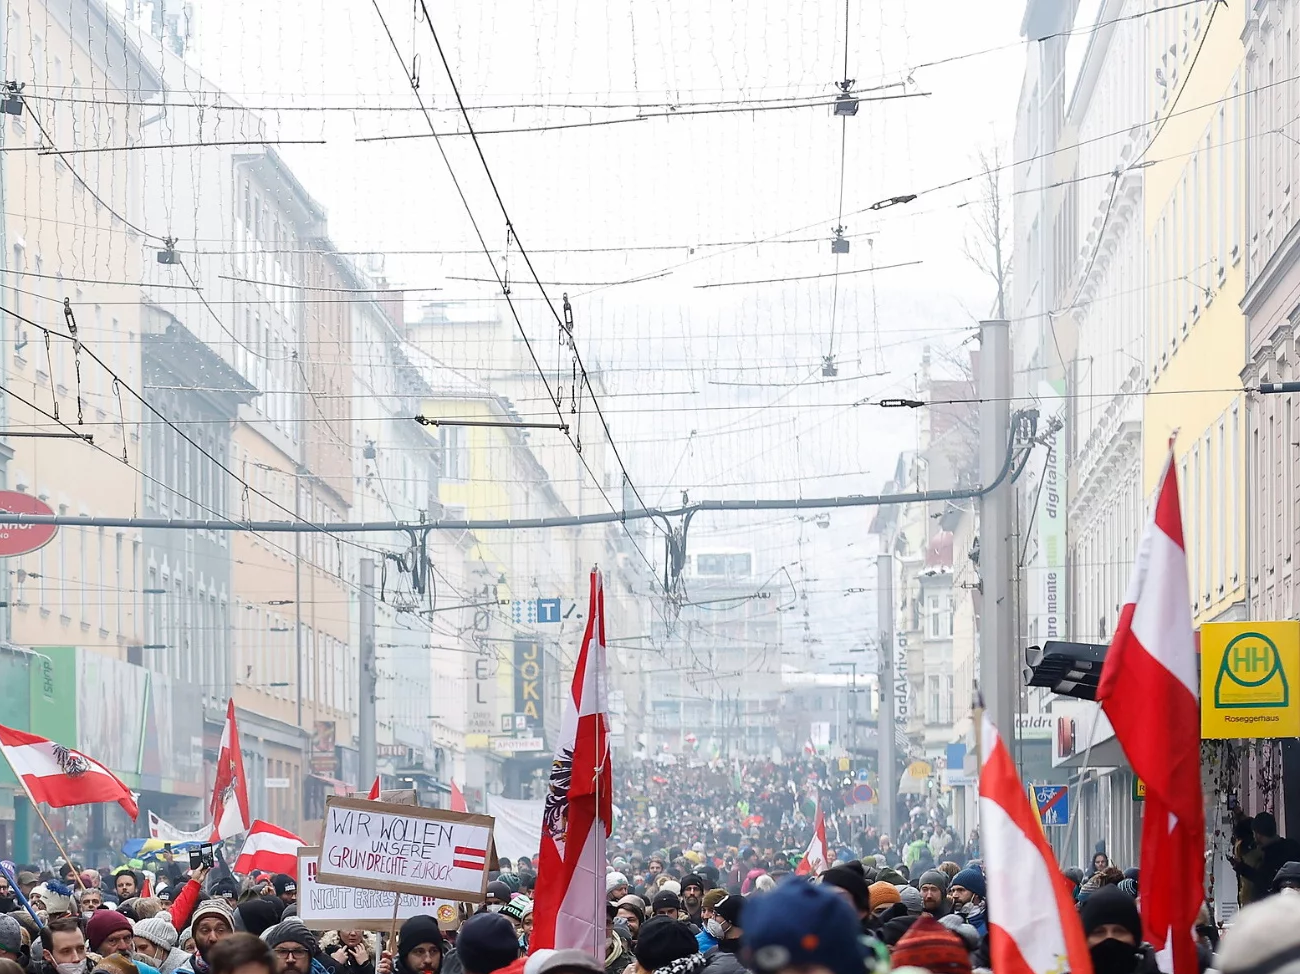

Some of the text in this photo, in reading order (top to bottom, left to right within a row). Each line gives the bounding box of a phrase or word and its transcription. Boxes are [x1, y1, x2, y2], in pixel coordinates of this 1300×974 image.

[1046, 572, 1057, 615] mente
[1046, 616, 1057, 638] pro
[520, 644, 540, 720] JOKA
[1224, 715, 1280, 723] Roseggerhaus
[497, 741, 541, 749] APOTHEKE
[332, 808, 454, 848] WIR WOLLEN
[328, 845, 409, 877] GRUNDRECHTE
[372, 841, 437, 860] UNSERE
[310, 887, 350, 911] NICHT
